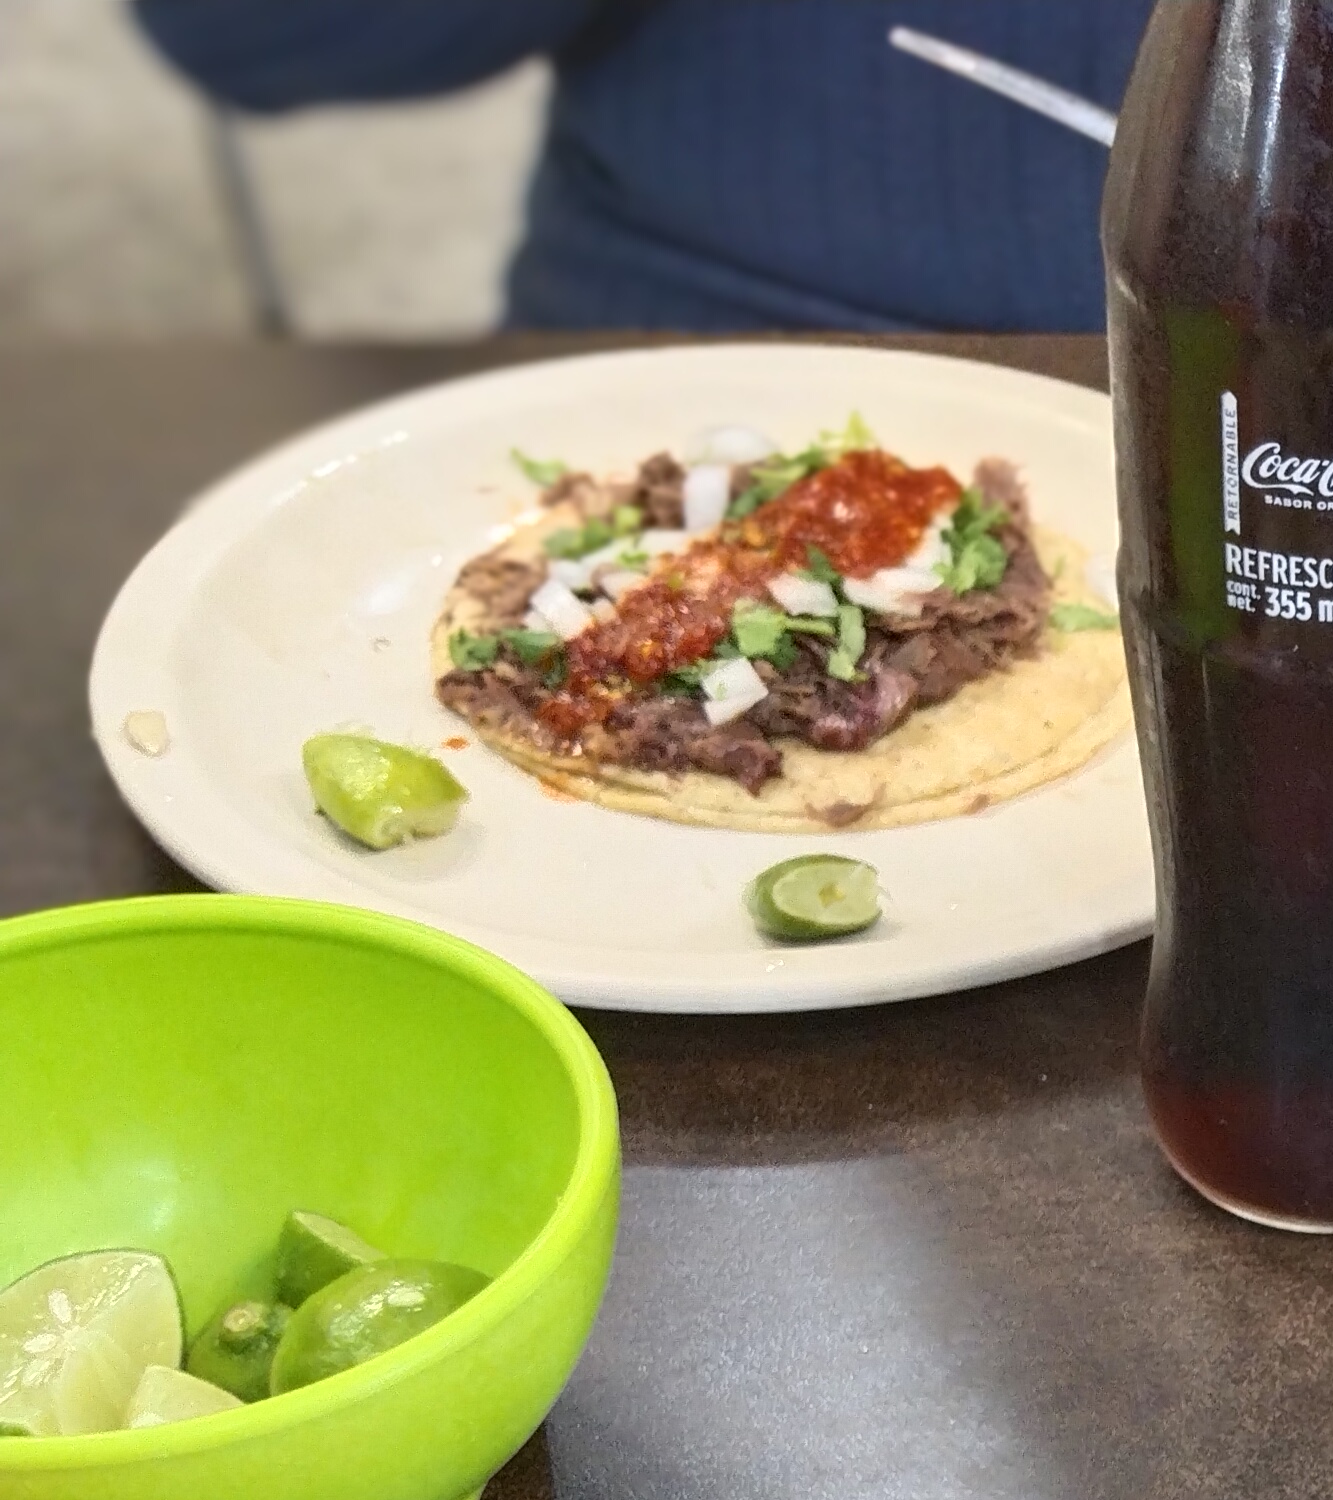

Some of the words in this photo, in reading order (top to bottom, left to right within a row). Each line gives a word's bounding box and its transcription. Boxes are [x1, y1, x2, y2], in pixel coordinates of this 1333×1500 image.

[1226, 408, 1238, 520] RETORNABLE
[1264, 495, 1312, 510] SABOR
[1226, 580, 1261, 600] cont.
[1264, 586, 1312, 621] 355
[1226, 594, 1256, 613] net.
